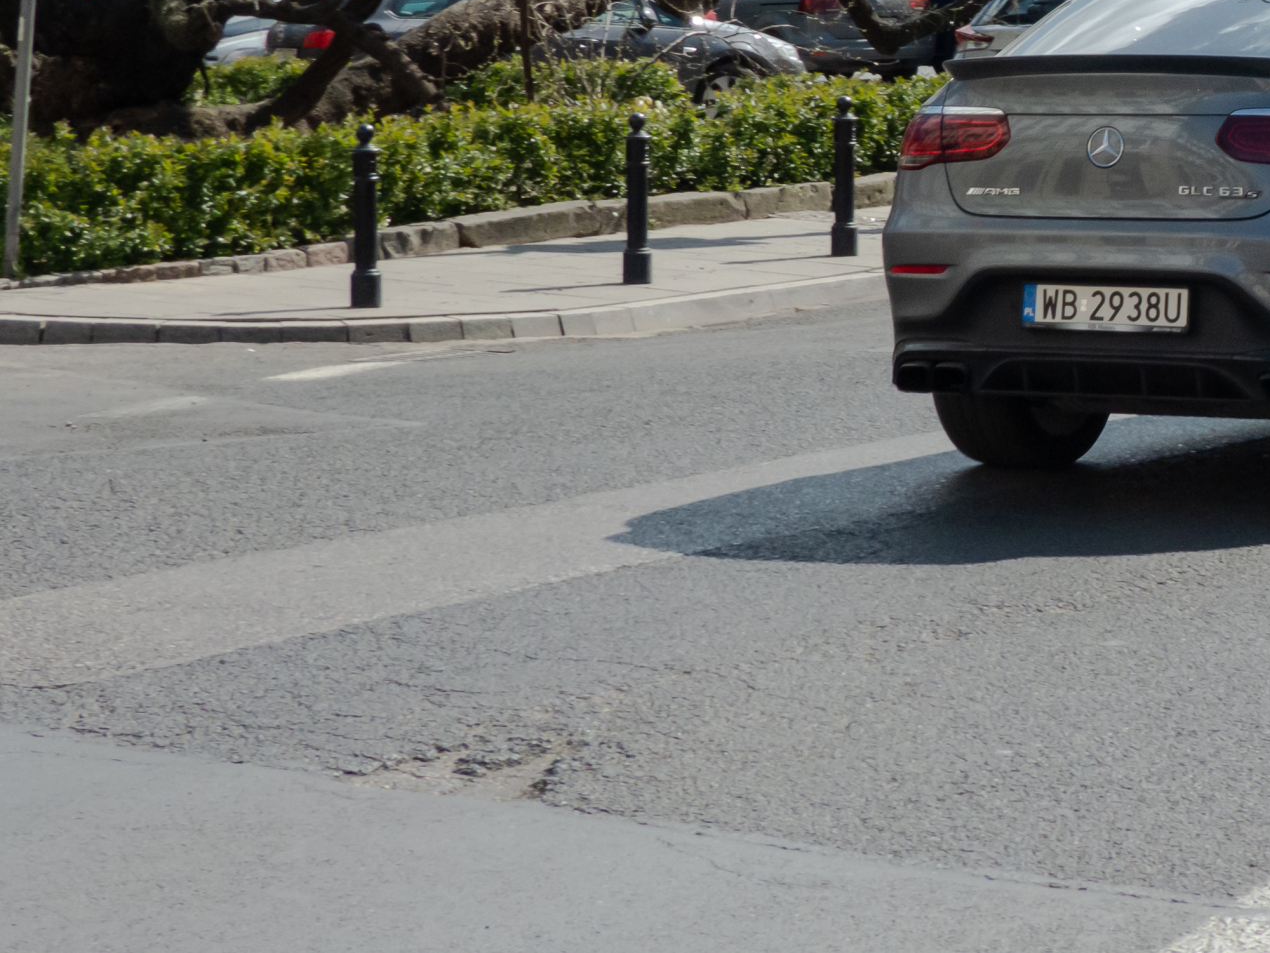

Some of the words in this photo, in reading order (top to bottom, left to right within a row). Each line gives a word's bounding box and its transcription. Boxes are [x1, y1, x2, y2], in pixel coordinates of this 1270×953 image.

[1178, 185, 1214, 196] GLC
[1219, 186, 1244, 197] 63
[1024, 307, 1034, 317] PL
[1042, 288, 1078, 321] WB
[1089, 290, 1182, 324] 2938U
